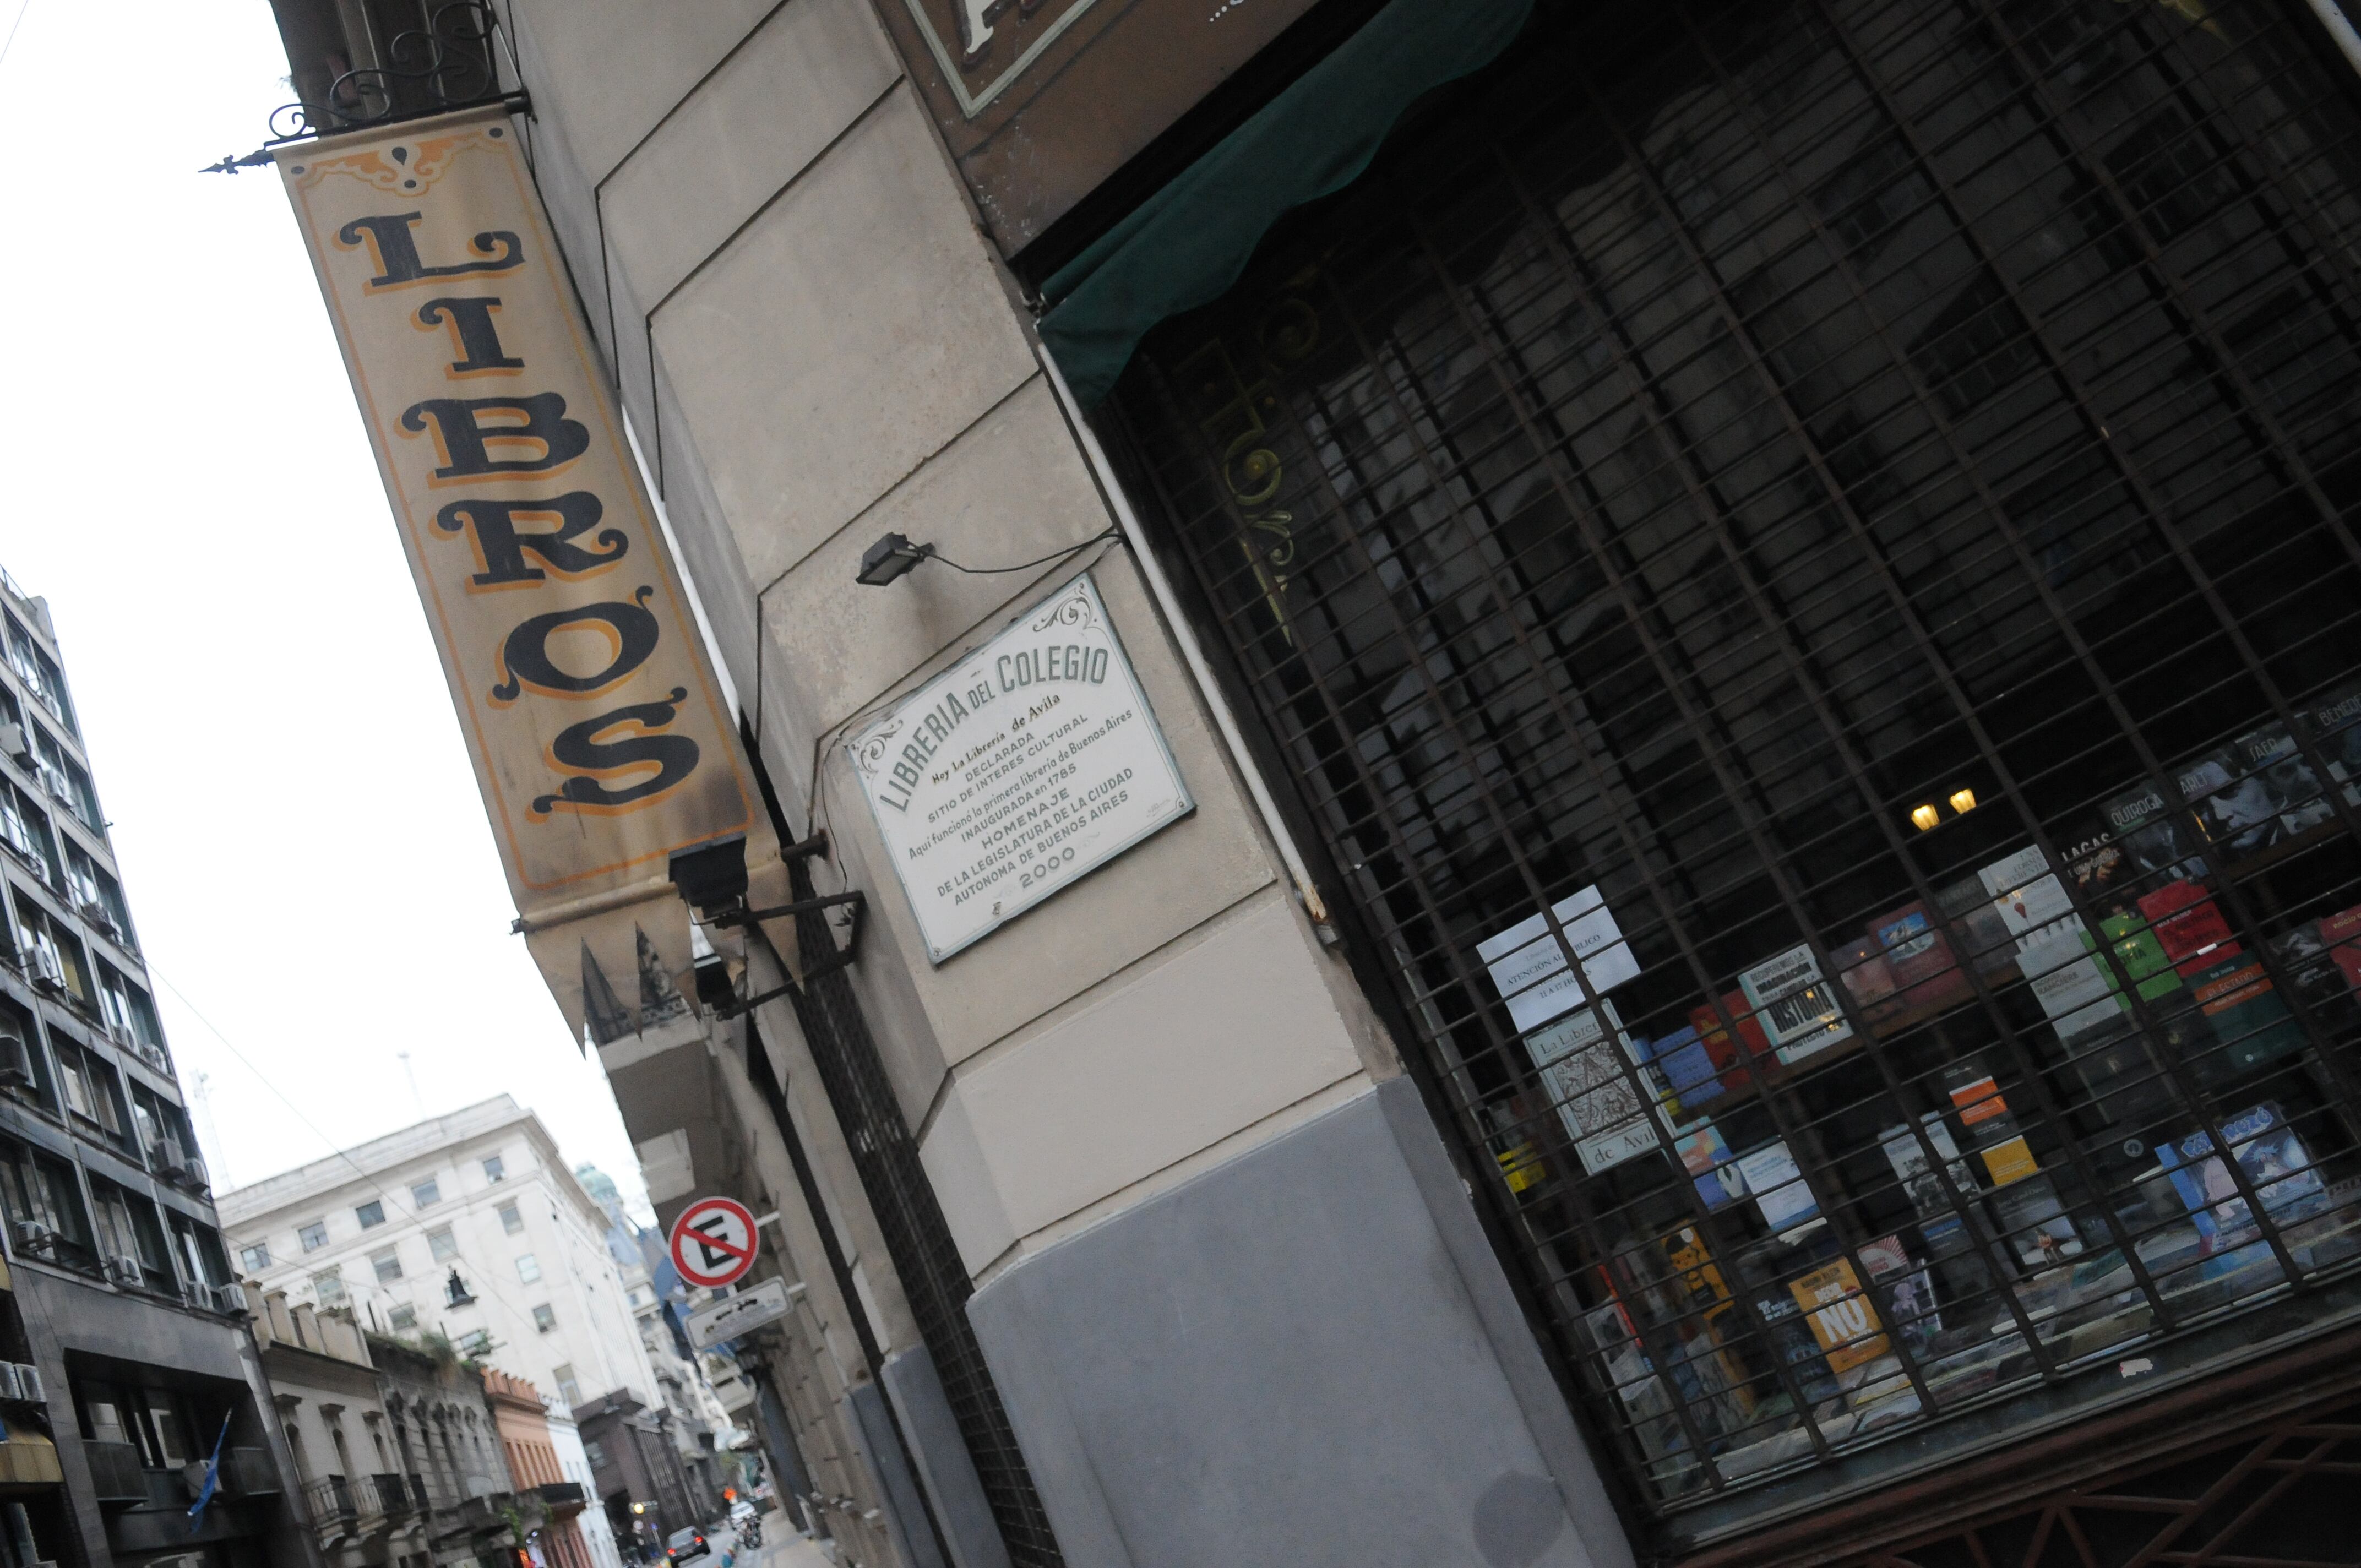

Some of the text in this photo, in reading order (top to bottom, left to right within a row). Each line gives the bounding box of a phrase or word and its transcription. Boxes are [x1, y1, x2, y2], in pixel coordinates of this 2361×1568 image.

[334, 211, 699, 816] LIBROS
[880, 645, 1108, 813] LIBRERIA DEL COLEGIO
[928, 714, 1088, 823] SITIO DE INTERES CULTURAL
[932, 695, 1060, 785] Hoy La Librería de Avila
[965, 732, 1035, 782] DECLARADA
[909, 710, 1133, 859] Aquí funcionó la primera librería de Buenos Aires
[961, 763, 1076, 842] INAUGURADA en 1785
[981, 788, 1070, 850] HOMENAJE
[2110, 793, 2164, 827] QUIROGA
[937, 768, 1133, 897] DE LA LEGISLATURA DE LA CIUDAD
[955, 790, 1128, 906] AUTONOMA DE BUENOS AIRES
[1019, 847, 1075, 889] 2000
[1540, 1022, 1599, 1054] La Librer
[1595, 1126, 1655, 1164] de Avil
[693, 1216, 738, 1270] E
